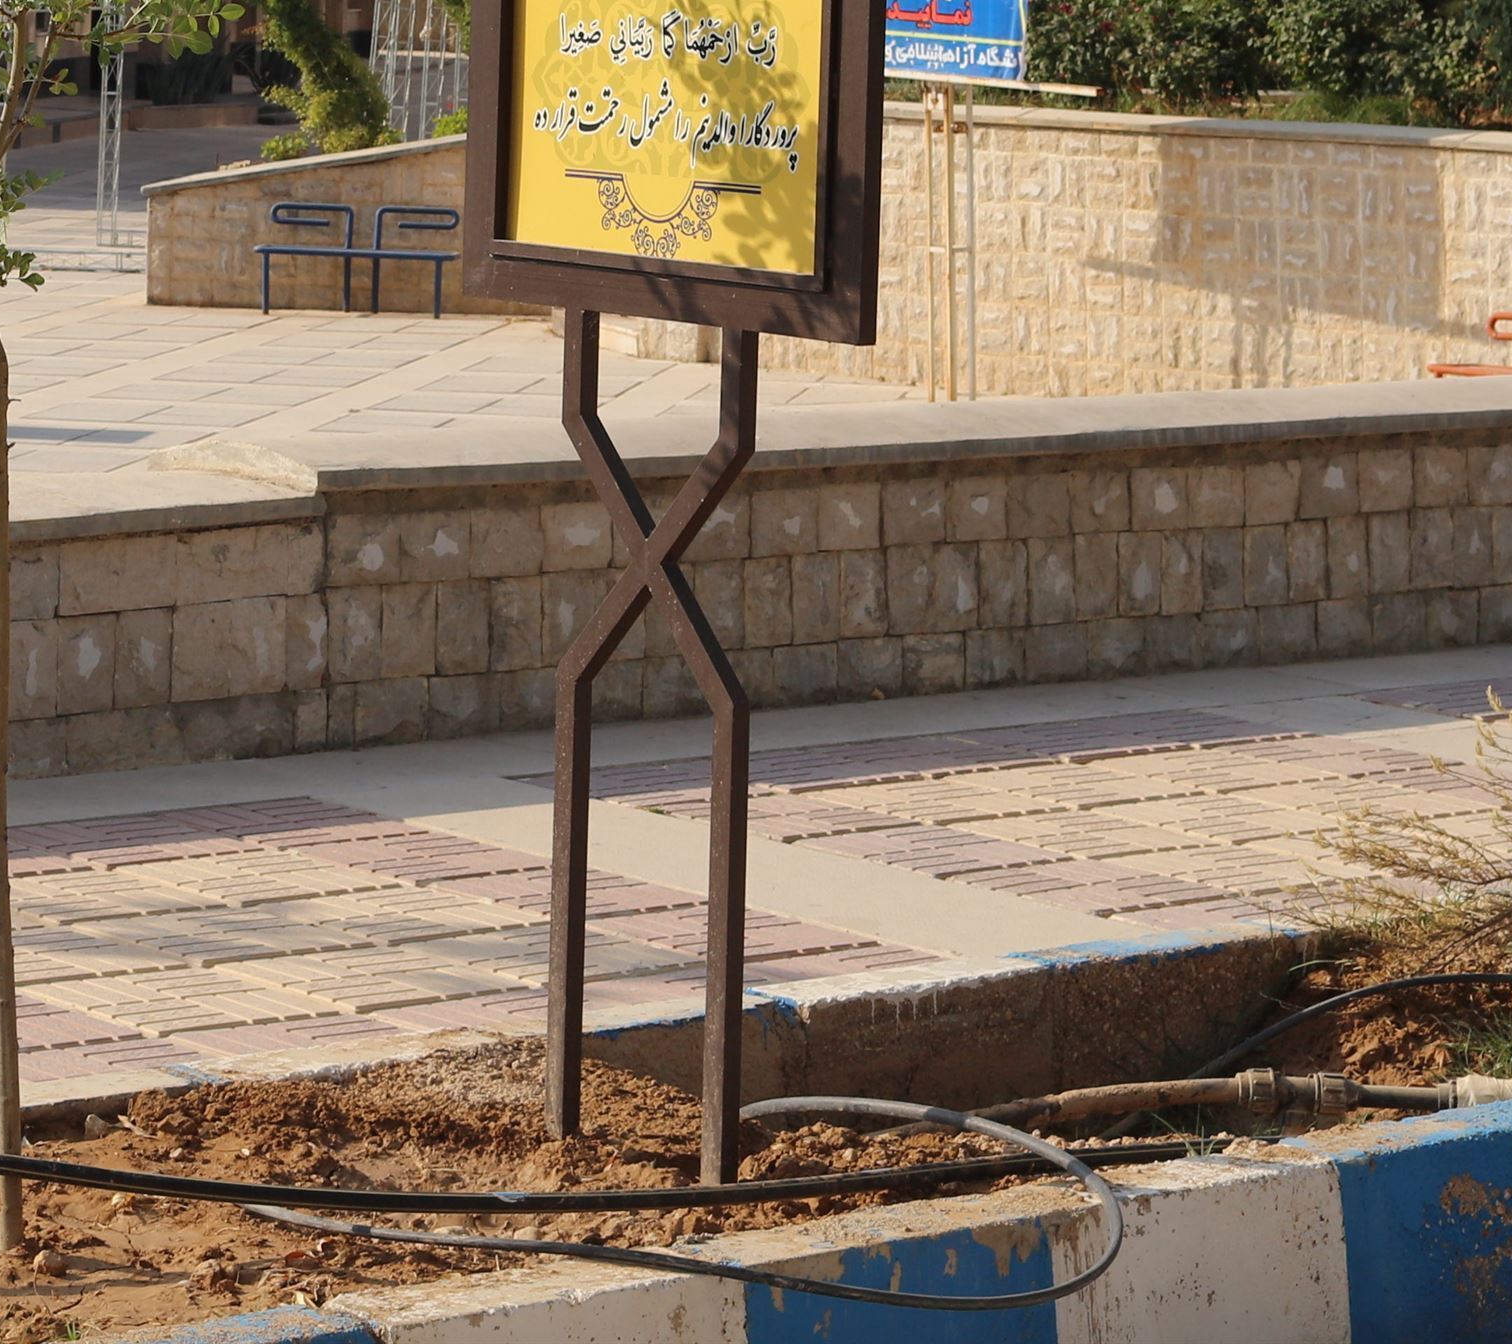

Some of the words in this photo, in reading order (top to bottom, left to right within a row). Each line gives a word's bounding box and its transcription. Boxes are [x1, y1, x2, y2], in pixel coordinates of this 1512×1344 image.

[976, 46, 1022, 69] انشگاه
[534, 109, 548, 129] ده
[550, 88, 578, 141] قرار
[577, 87, 630, 135] رحمت
[629, 80, 674, 147] مشمول
[675, 109, 689, 141] را
[740, 100, 799, 172] پروردگارا
